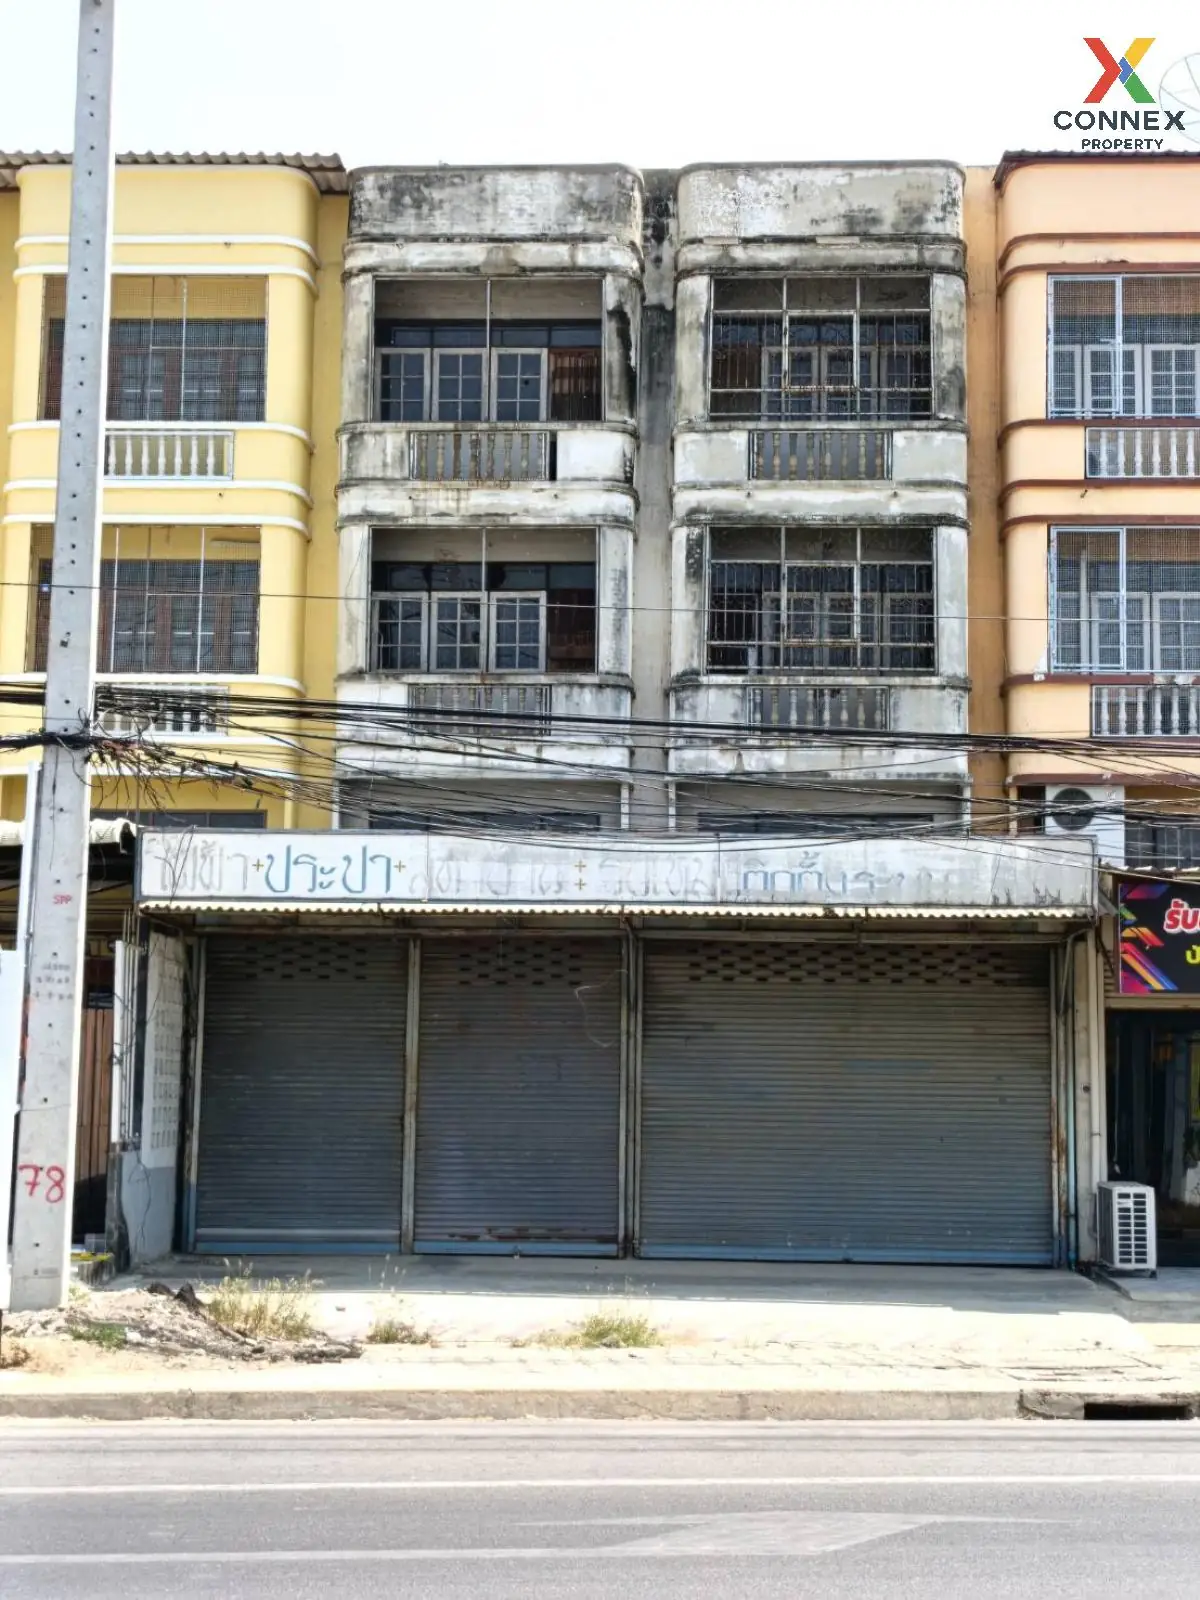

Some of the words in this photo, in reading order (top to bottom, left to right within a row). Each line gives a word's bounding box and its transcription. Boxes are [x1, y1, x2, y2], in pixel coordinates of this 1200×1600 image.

[264, 844, 392, 895] ประปา
[1164, 898, 1200, 934] รับ
[18, 1164, 66, 1204] 78
